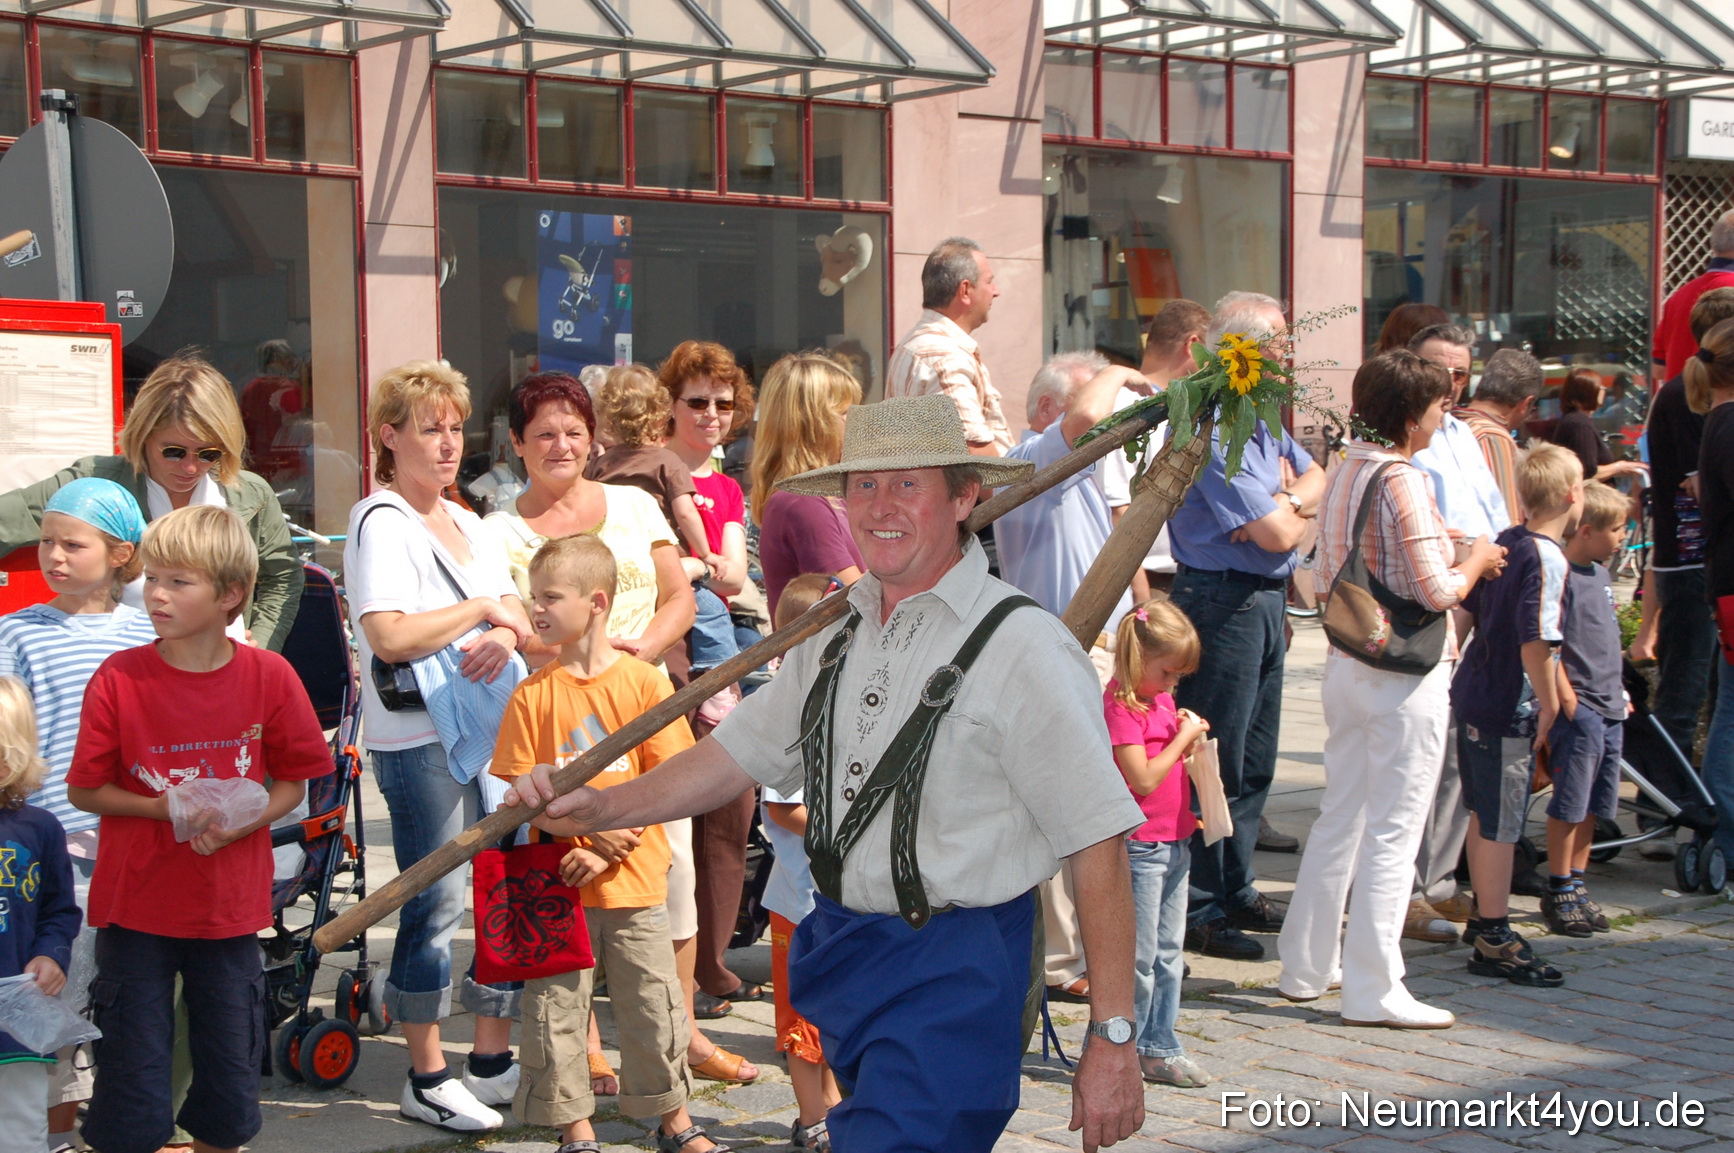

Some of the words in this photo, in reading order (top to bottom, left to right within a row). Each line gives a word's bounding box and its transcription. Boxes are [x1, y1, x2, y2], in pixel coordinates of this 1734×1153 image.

[553, 320, 574, 339] go
[70, 344, 98, 354] swn
[171, 738, 250, 752] DIRECTIONS
